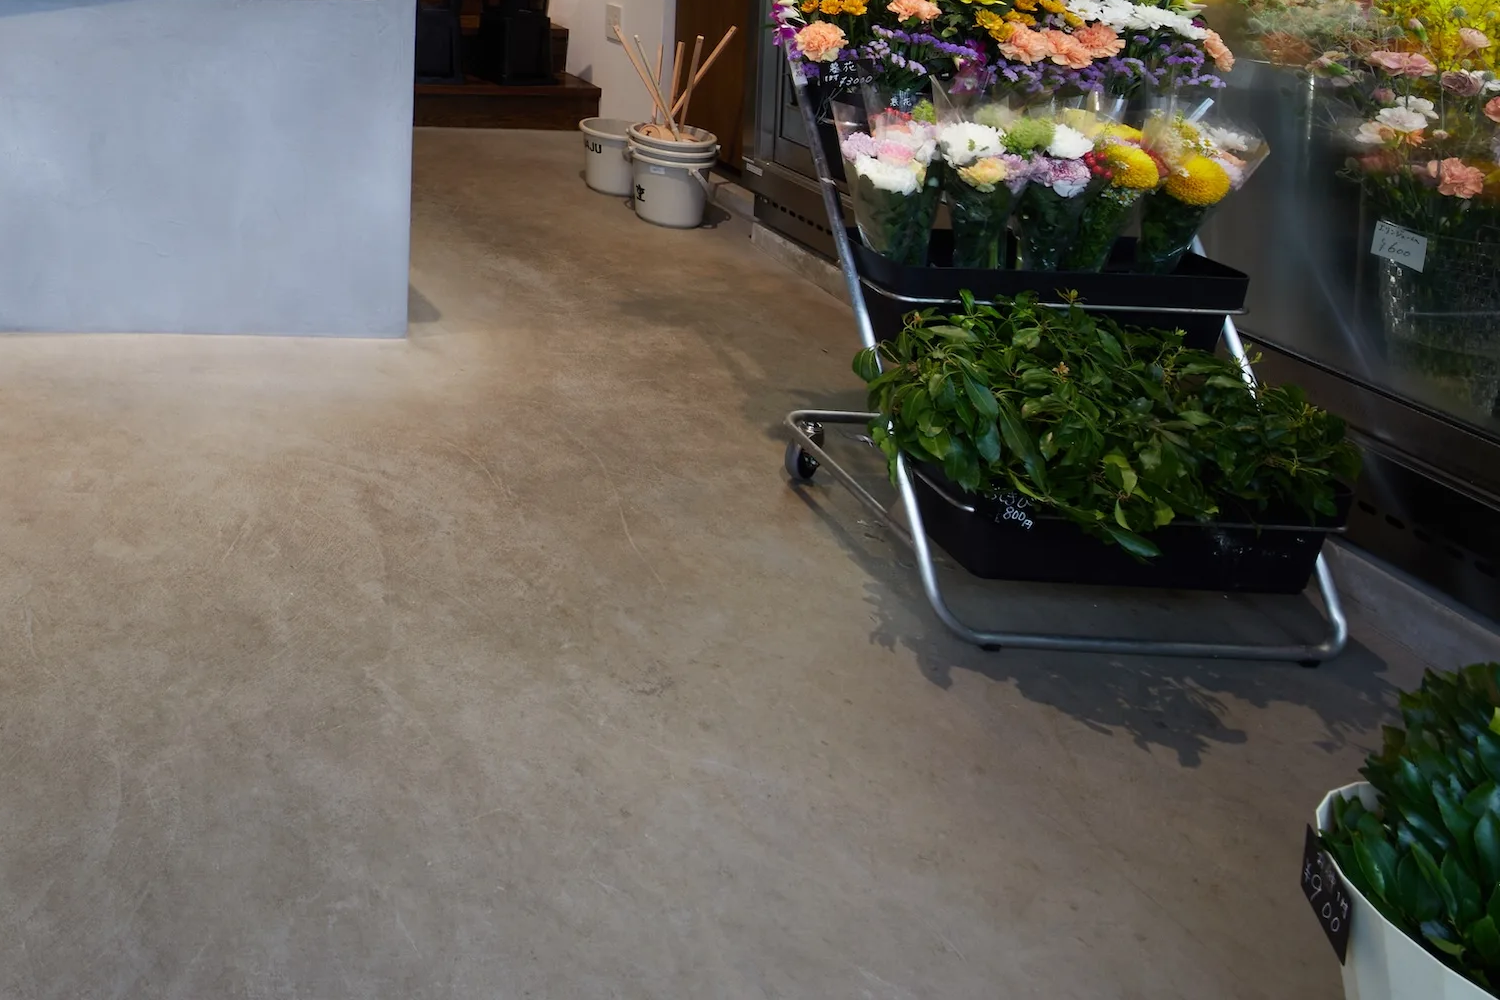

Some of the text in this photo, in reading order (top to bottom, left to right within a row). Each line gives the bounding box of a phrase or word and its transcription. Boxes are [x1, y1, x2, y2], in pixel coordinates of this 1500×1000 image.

[839, 75, 873, 88] ¥3000
[1379, 238, 1411, 257] ¥600
[1002, 506, 1034, 530] 800円
[1303, 860, 1341, 932] ¥900
